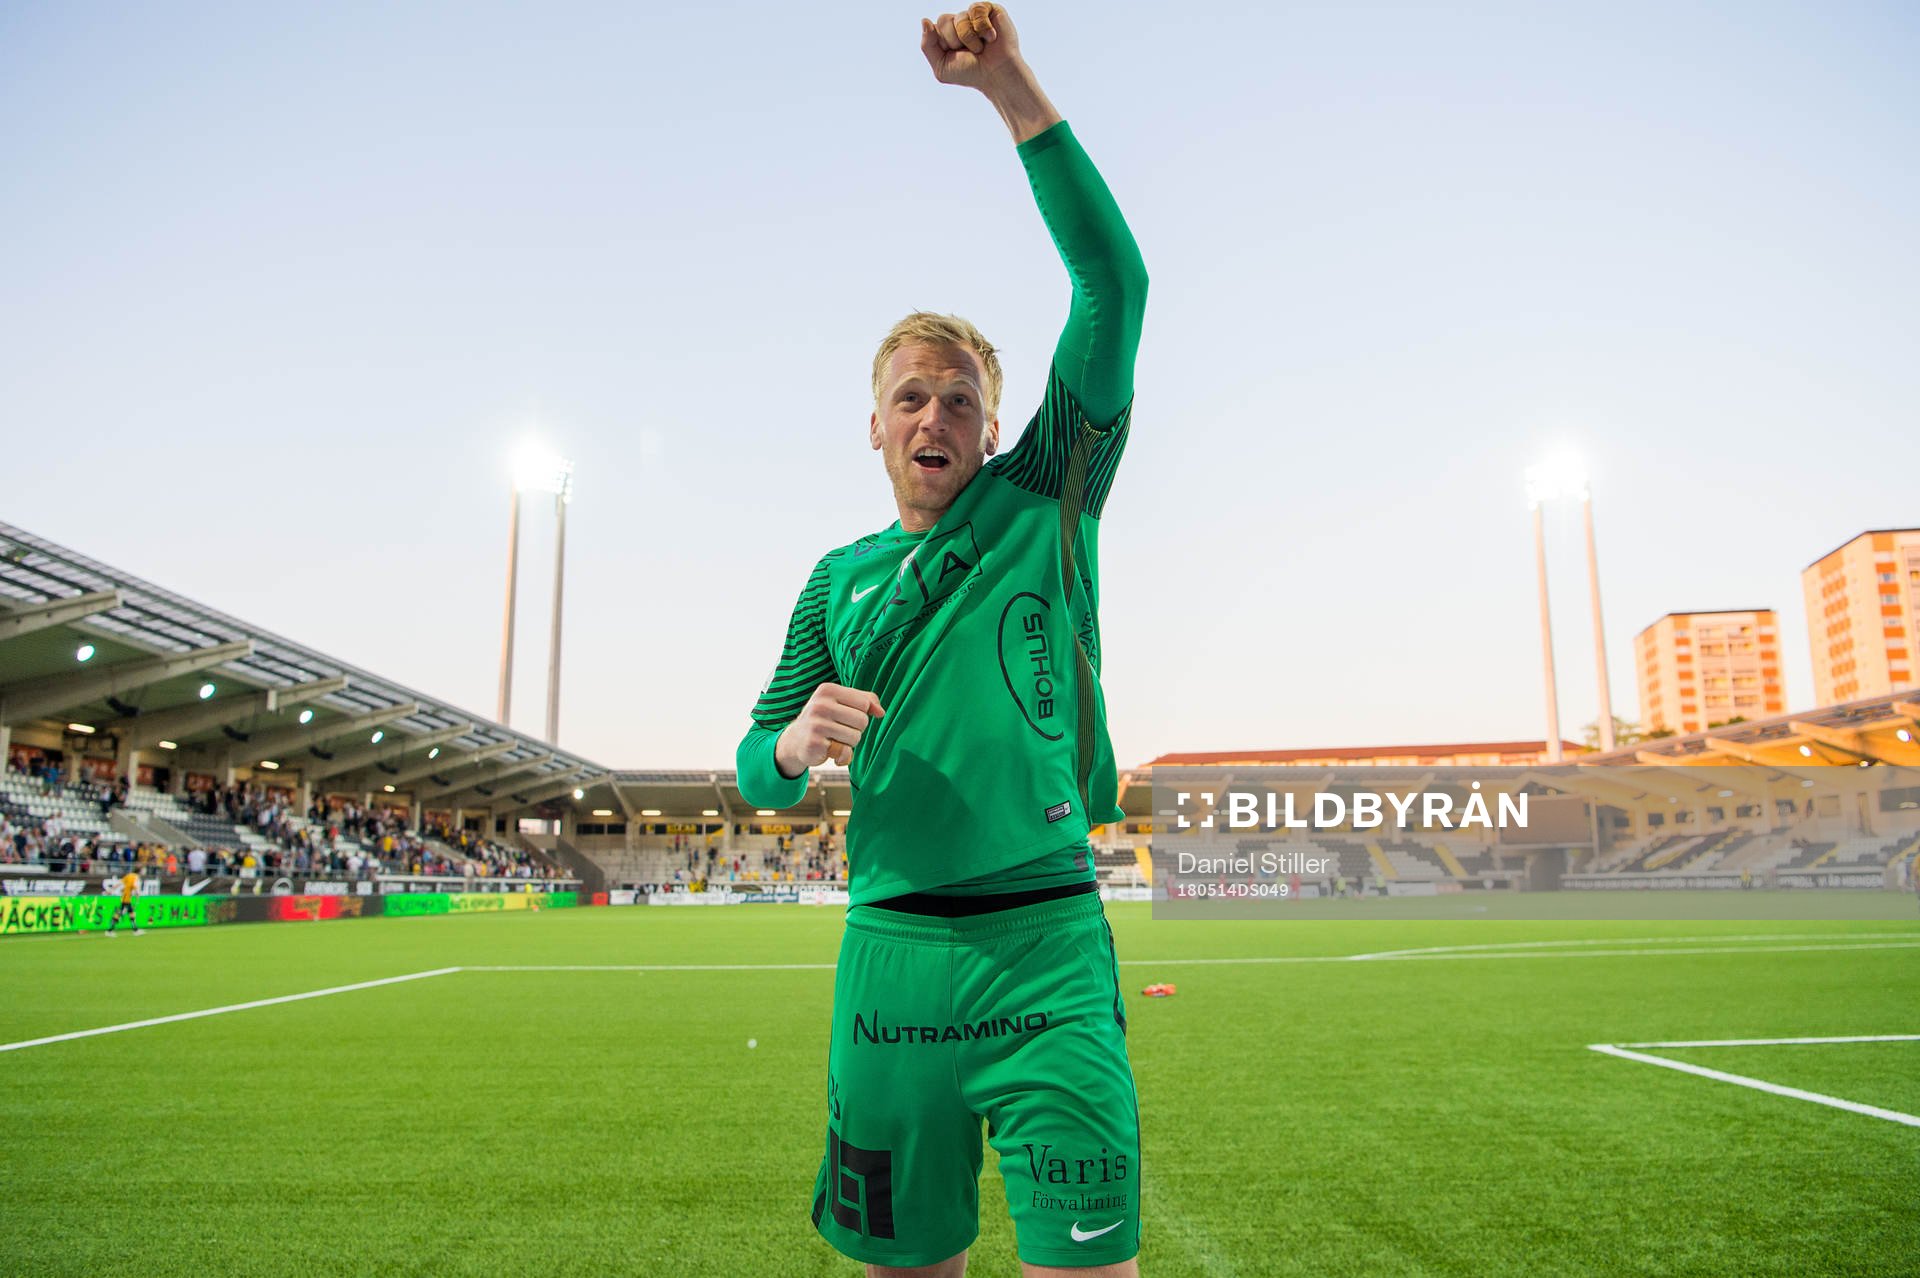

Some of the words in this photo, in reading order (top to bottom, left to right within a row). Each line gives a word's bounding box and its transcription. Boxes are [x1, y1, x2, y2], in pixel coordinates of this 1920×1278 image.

[1023, 613, 1054, 720] BOHUS
[1022, 1144, 1126, 1184] Varis
[1032, 1190, 1127, 1211] Förvaltning
